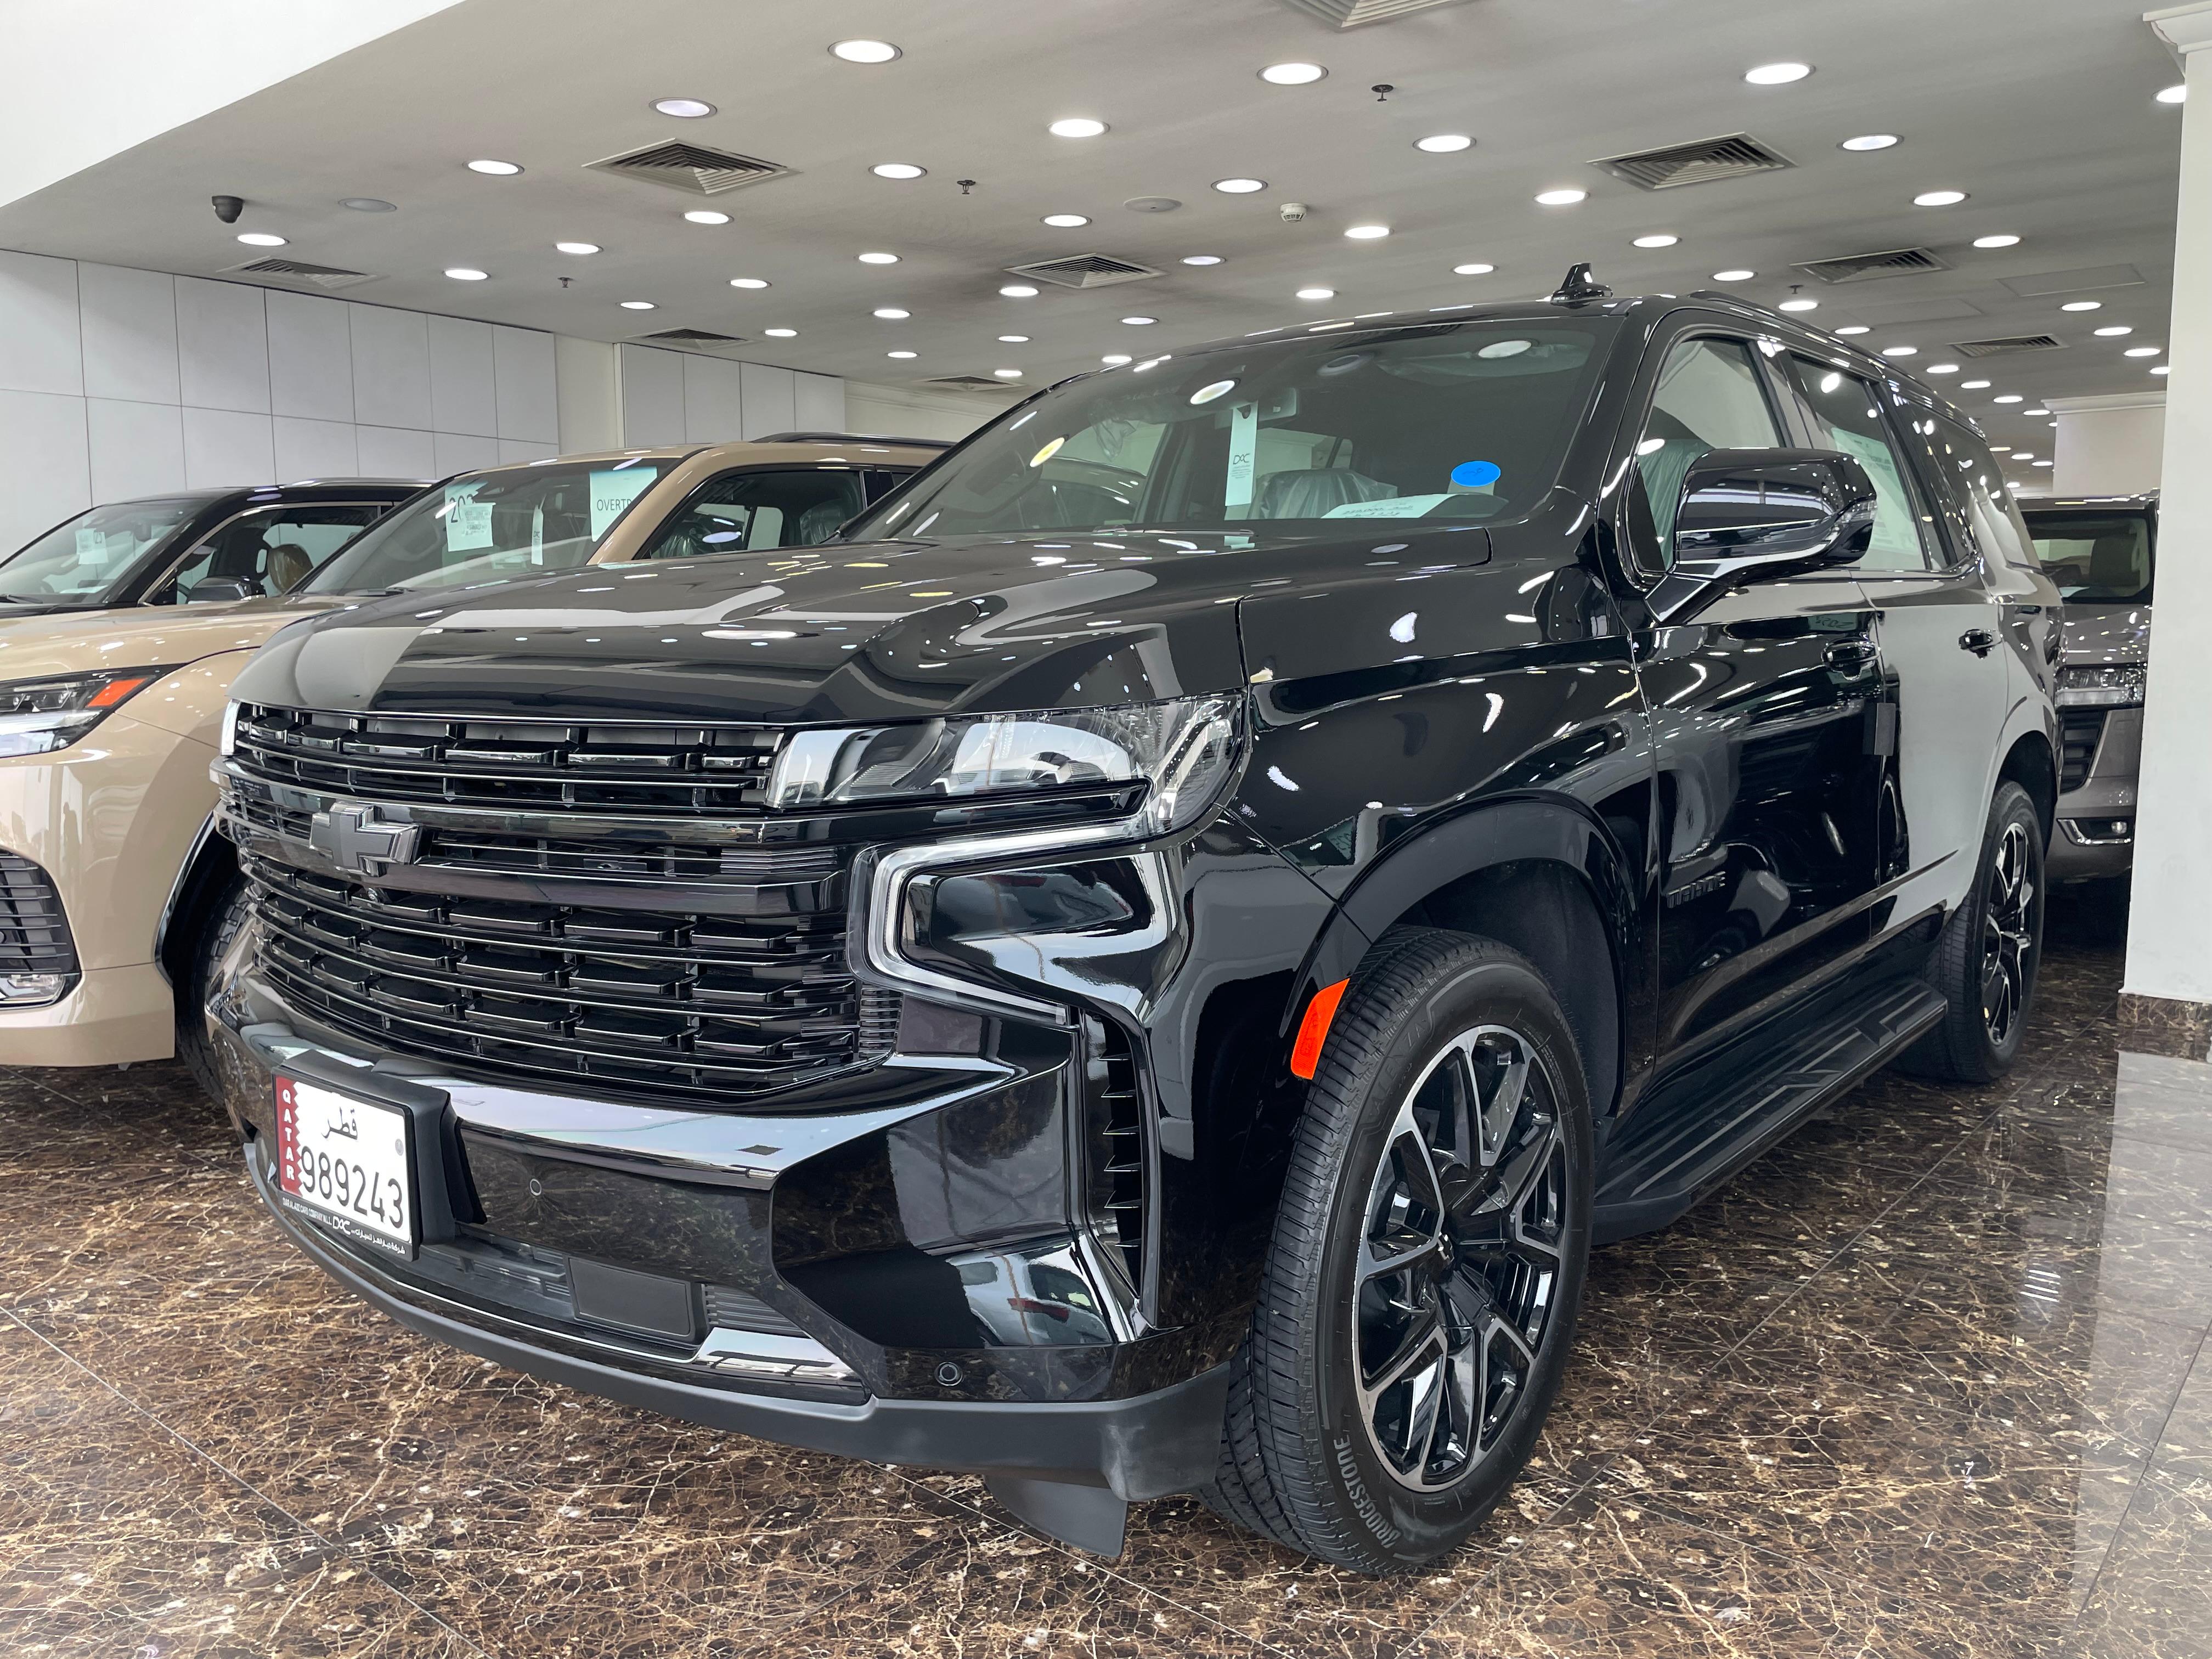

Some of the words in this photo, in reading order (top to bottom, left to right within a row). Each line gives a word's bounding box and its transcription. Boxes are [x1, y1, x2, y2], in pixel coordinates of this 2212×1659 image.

[282, 1089, 295, 1181] QATAR
[321, 1106, 358, 1141] قطر
[301, 1146, 404, 1229] 989243
[1333, 1434, 1401, 1549] BRIDGESTONE
